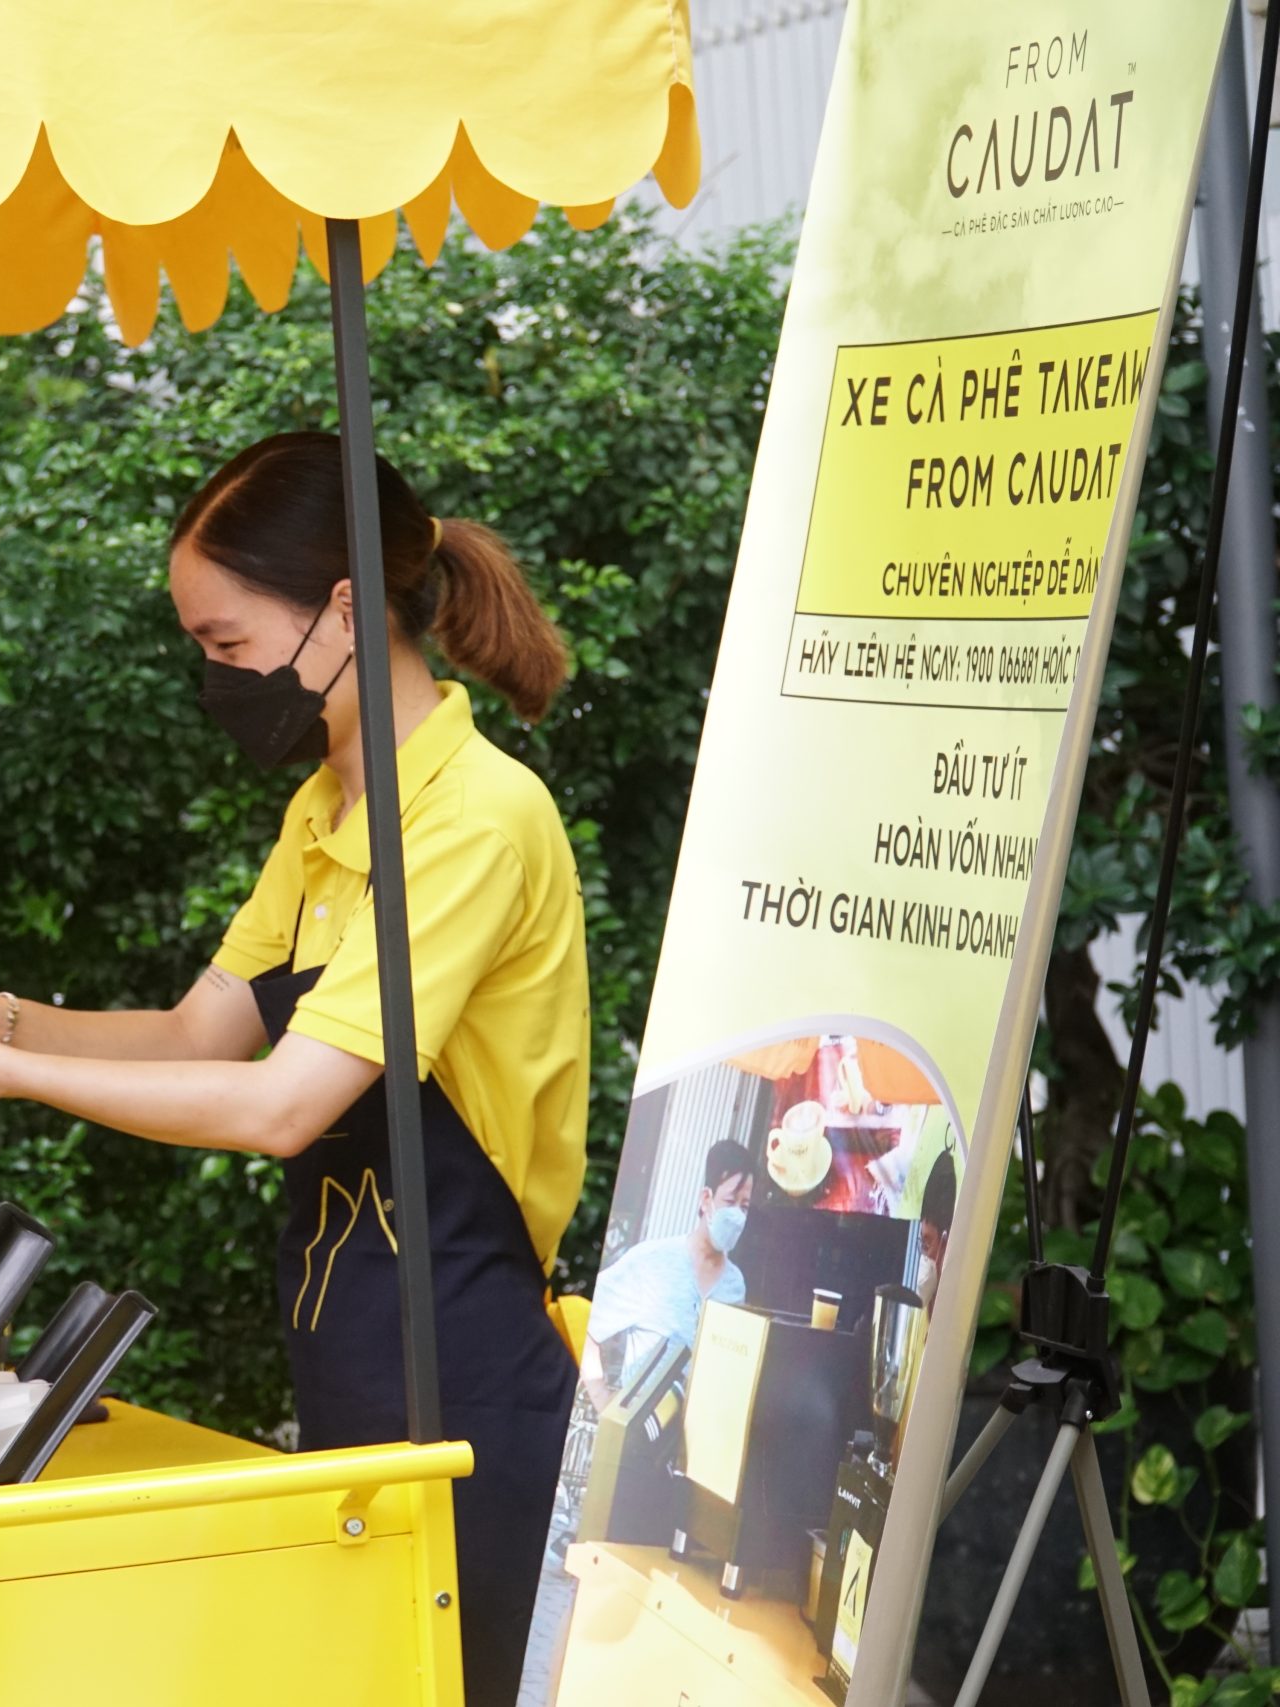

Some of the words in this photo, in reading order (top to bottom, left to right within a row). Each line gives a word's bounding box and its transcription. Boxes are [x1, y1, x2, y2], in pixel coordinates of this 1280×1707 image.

[1005, 28, 1088, 89] FROM
[946, 89, 1134, 199] CAUDAT
[1095, 195, 1113, 214] CAO
[841, 376, 891, 426] XE
[906, 355, 945, 425] CÀ
[960, 348, 1023, 421] PHÊ
[906, 453, 995, 509] FROM
[1008, 443, 1122, 506] CAUDAT
[882, 551, 965, 596] CHUYÊN
[970, 549, 1044, 606] NGHIỆP
[1047, 536, 1072, 596] DỄ
[799, 630, 839, 674] HÃY
[844, 632, 889, 678] LIÊN
[893, 633, 916, 688] HỆ
[920, 644, 960, 682] NGAY:
[966, 646, 994, 683] 1900
[998, 646, 1039, 684] 066881
[1040, 634, 1071, 694] HOẶC
[933, 738, 976, 796] ĐẦU
[982, 752, 1010, 799] TƯ
[1010, 745, 1028, 800] ÍT
[874, 816, 942, 870] HOÀN
[948, 817, 990, 876] VỐN
[741, 877, 822, 930] THỜI
[829, 893, 895, 941] GIAN
[900, 902, 952, 949] KINH
[956, 908, 1018, 959] DOANH
